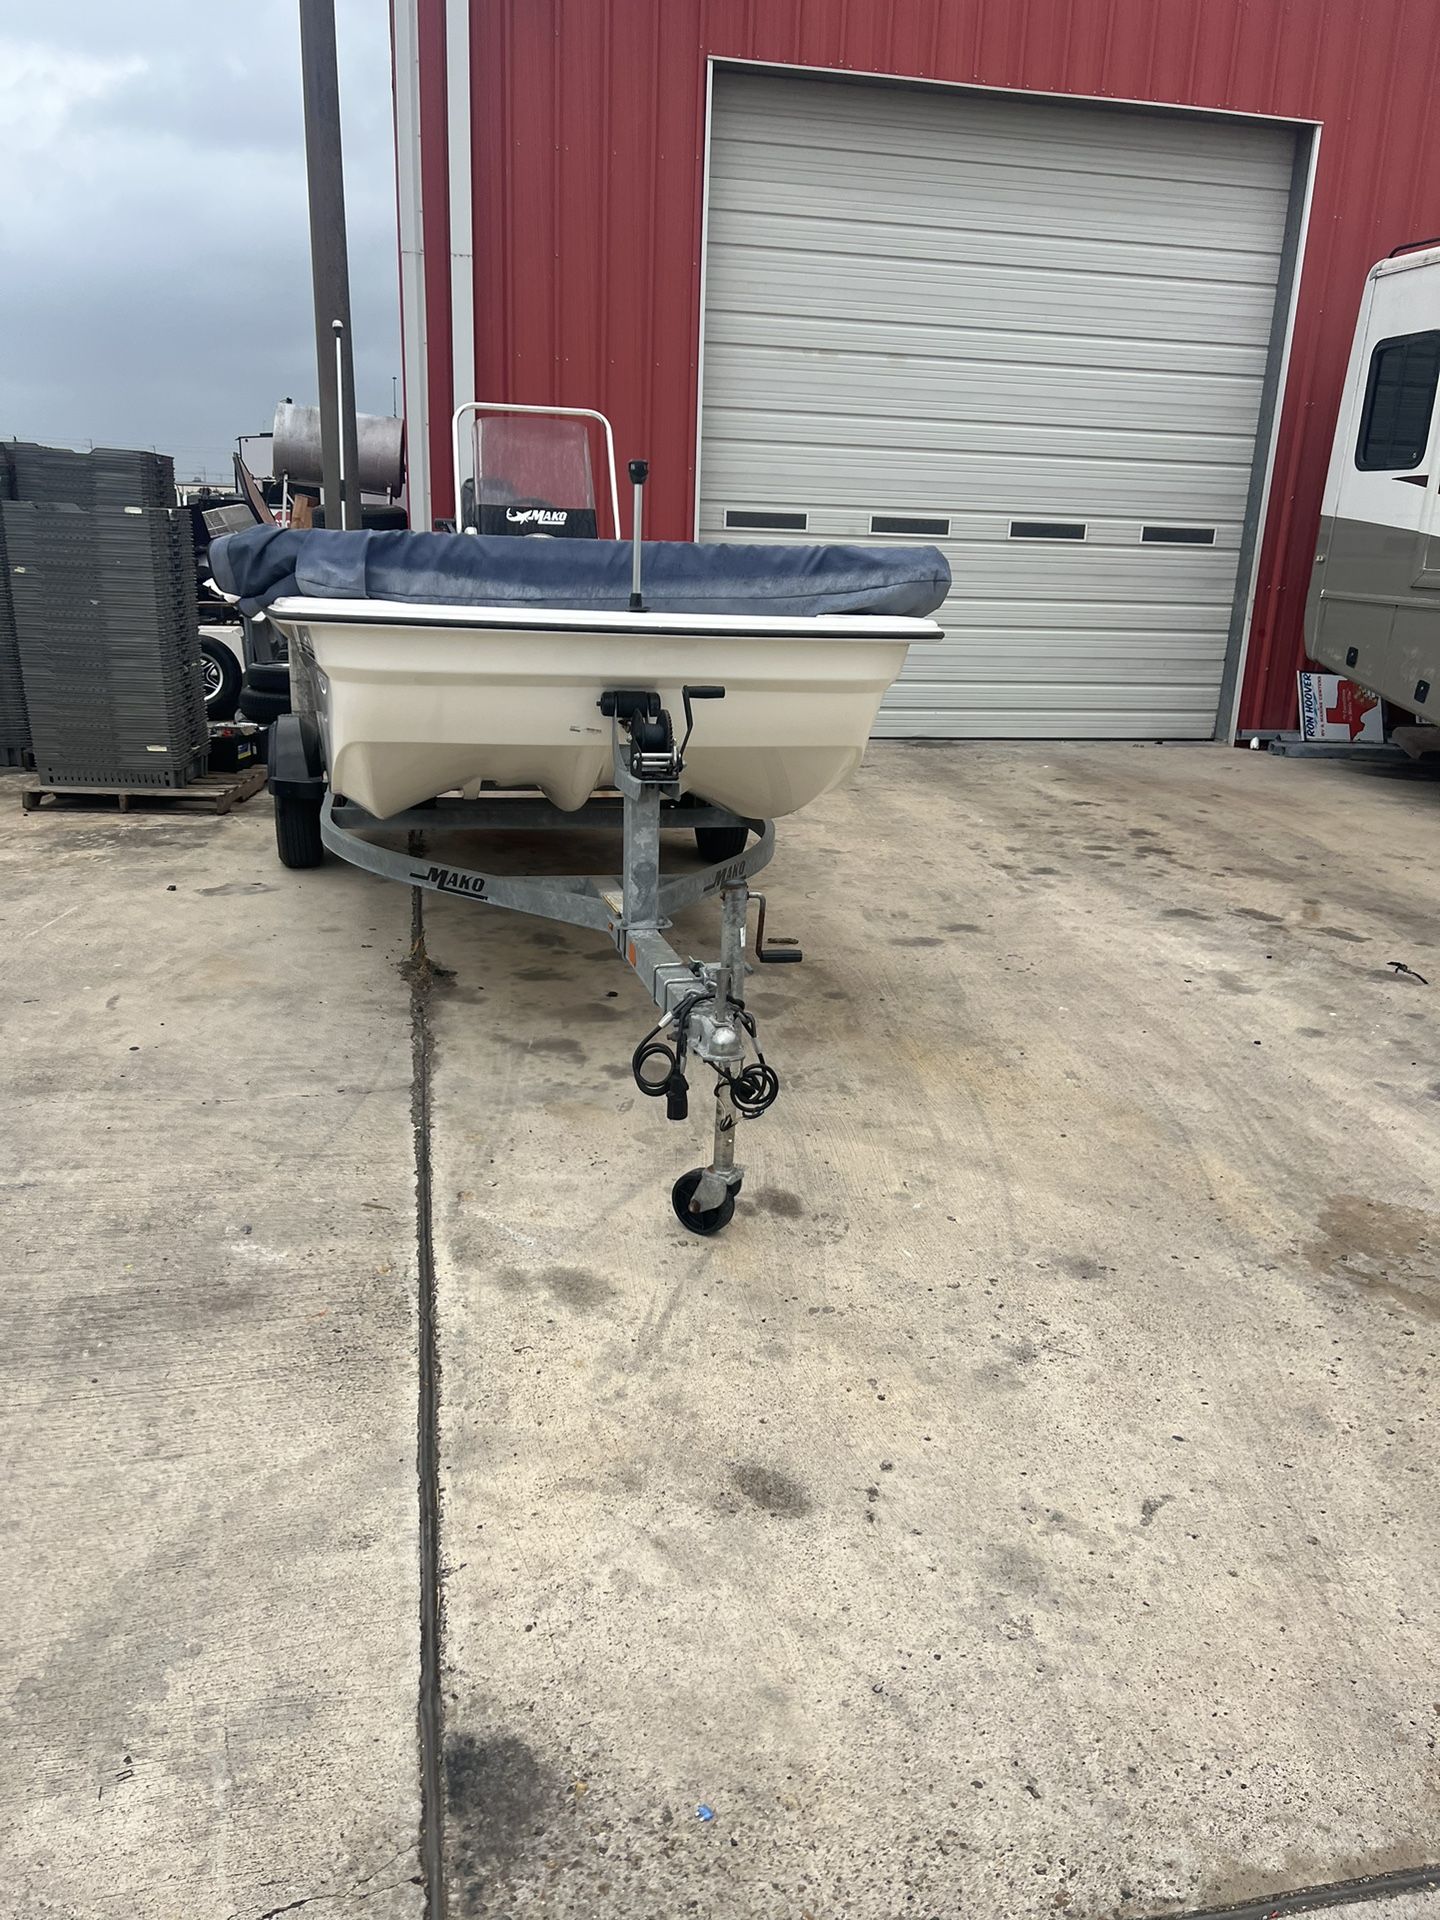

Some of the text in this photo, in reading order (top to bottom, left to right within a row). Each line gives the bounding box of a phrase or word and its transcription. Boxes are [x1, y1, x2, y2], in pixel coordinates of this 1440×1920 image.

[529, 509, 568, 524] MAKO
[1303, 672, 1315, 737] RON HOOVER
[420, 867, 487, 896] MAKO
[709, 860, 746, 888] MAKO
